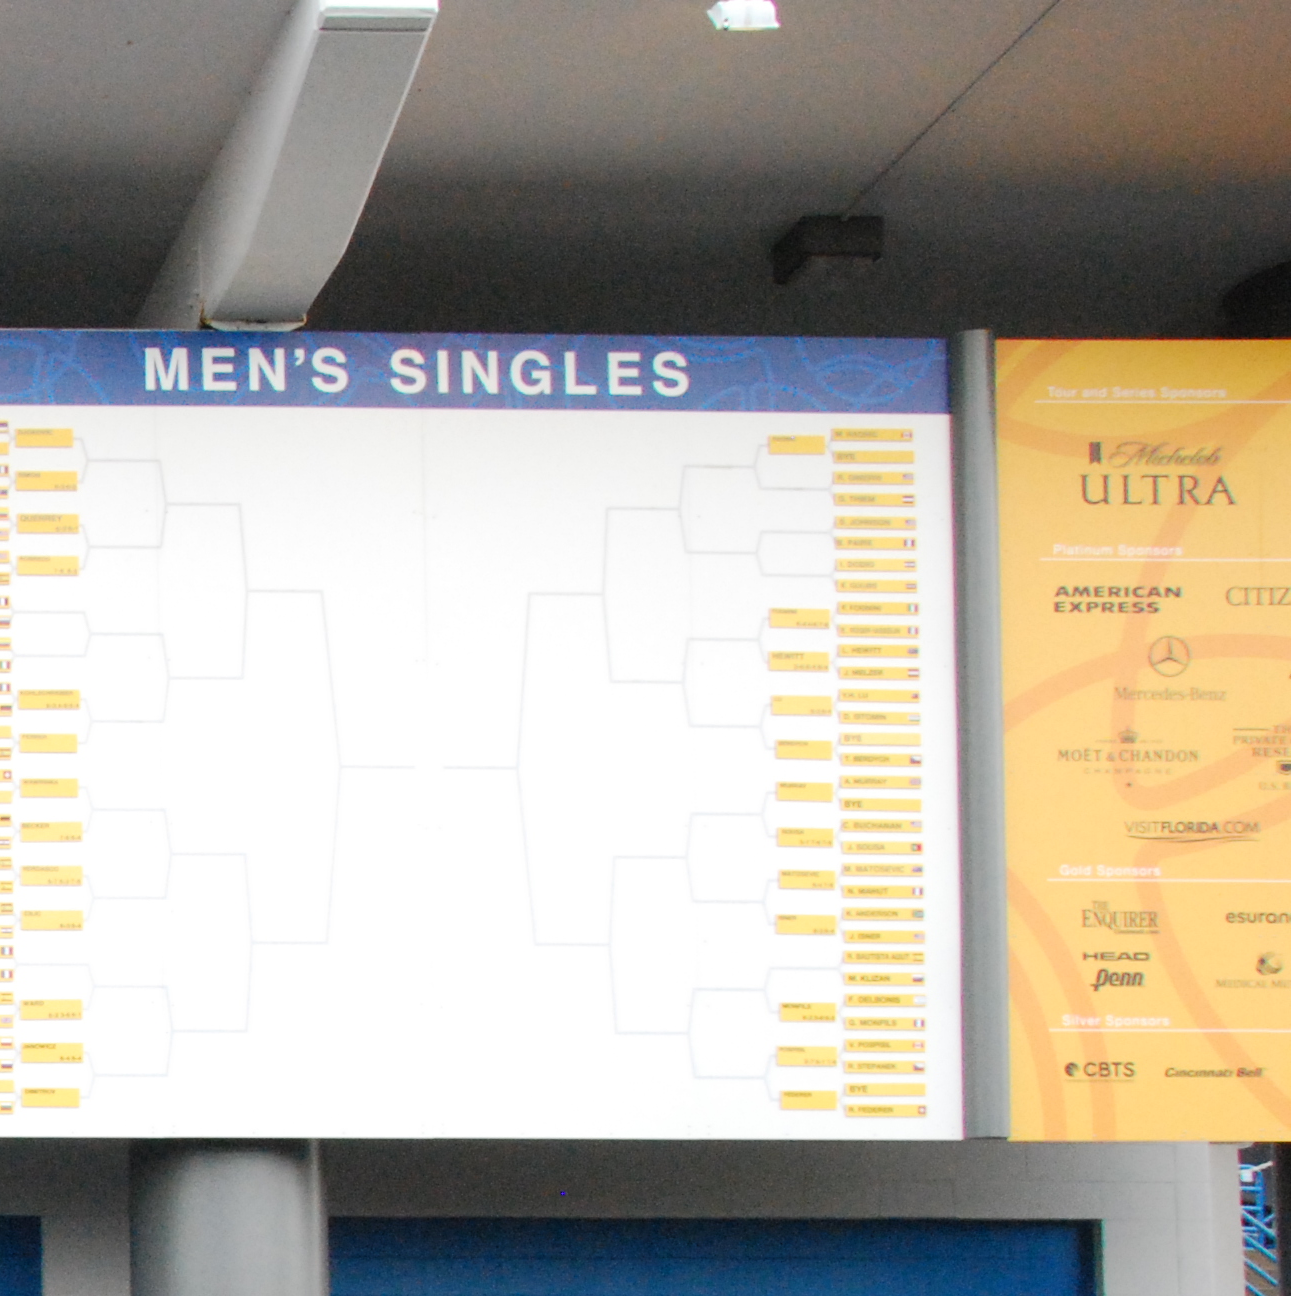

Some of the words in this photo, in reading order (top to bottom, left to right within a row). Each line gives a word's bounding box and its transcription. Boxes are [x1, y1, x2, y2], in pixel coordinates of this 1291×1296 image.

[144, 345, 350, 393] MEN'S
[391, 348, 692, 400] SINGLES
[1048, 386, 1077, 397] Tour
[1082, 387, 1107, 397] and
[1112, 387, 1156, 397] Series
[1161, 387, 1227, 399] Sponsors
[1080, 474, 1237, 505] ULTRA
[1053, 544, 1113, 555] Platinum
[1118, 545, 1184, 557] Sponsors
[1055, 586, 1184, 598] AMERICAN
[1054, 602, 1161, 613] EXPRESS
[1120, 750, 1199, 762] CHANDON
[1059, 865, 1091, 876] Gold
[1097, 866, 1161, 878] Sponsors
[1082, 909, 1159, 929] ENQUIRER
[1226, 912, 1291, 923] esuran
[1082, 952, 1150, 961] HEAD
[1062, 1015, 1101, 1026] Silver
[1105, 1016, 1170, 1028] Sponsors
[1084, 1062, 1136, 1077] CBTS
